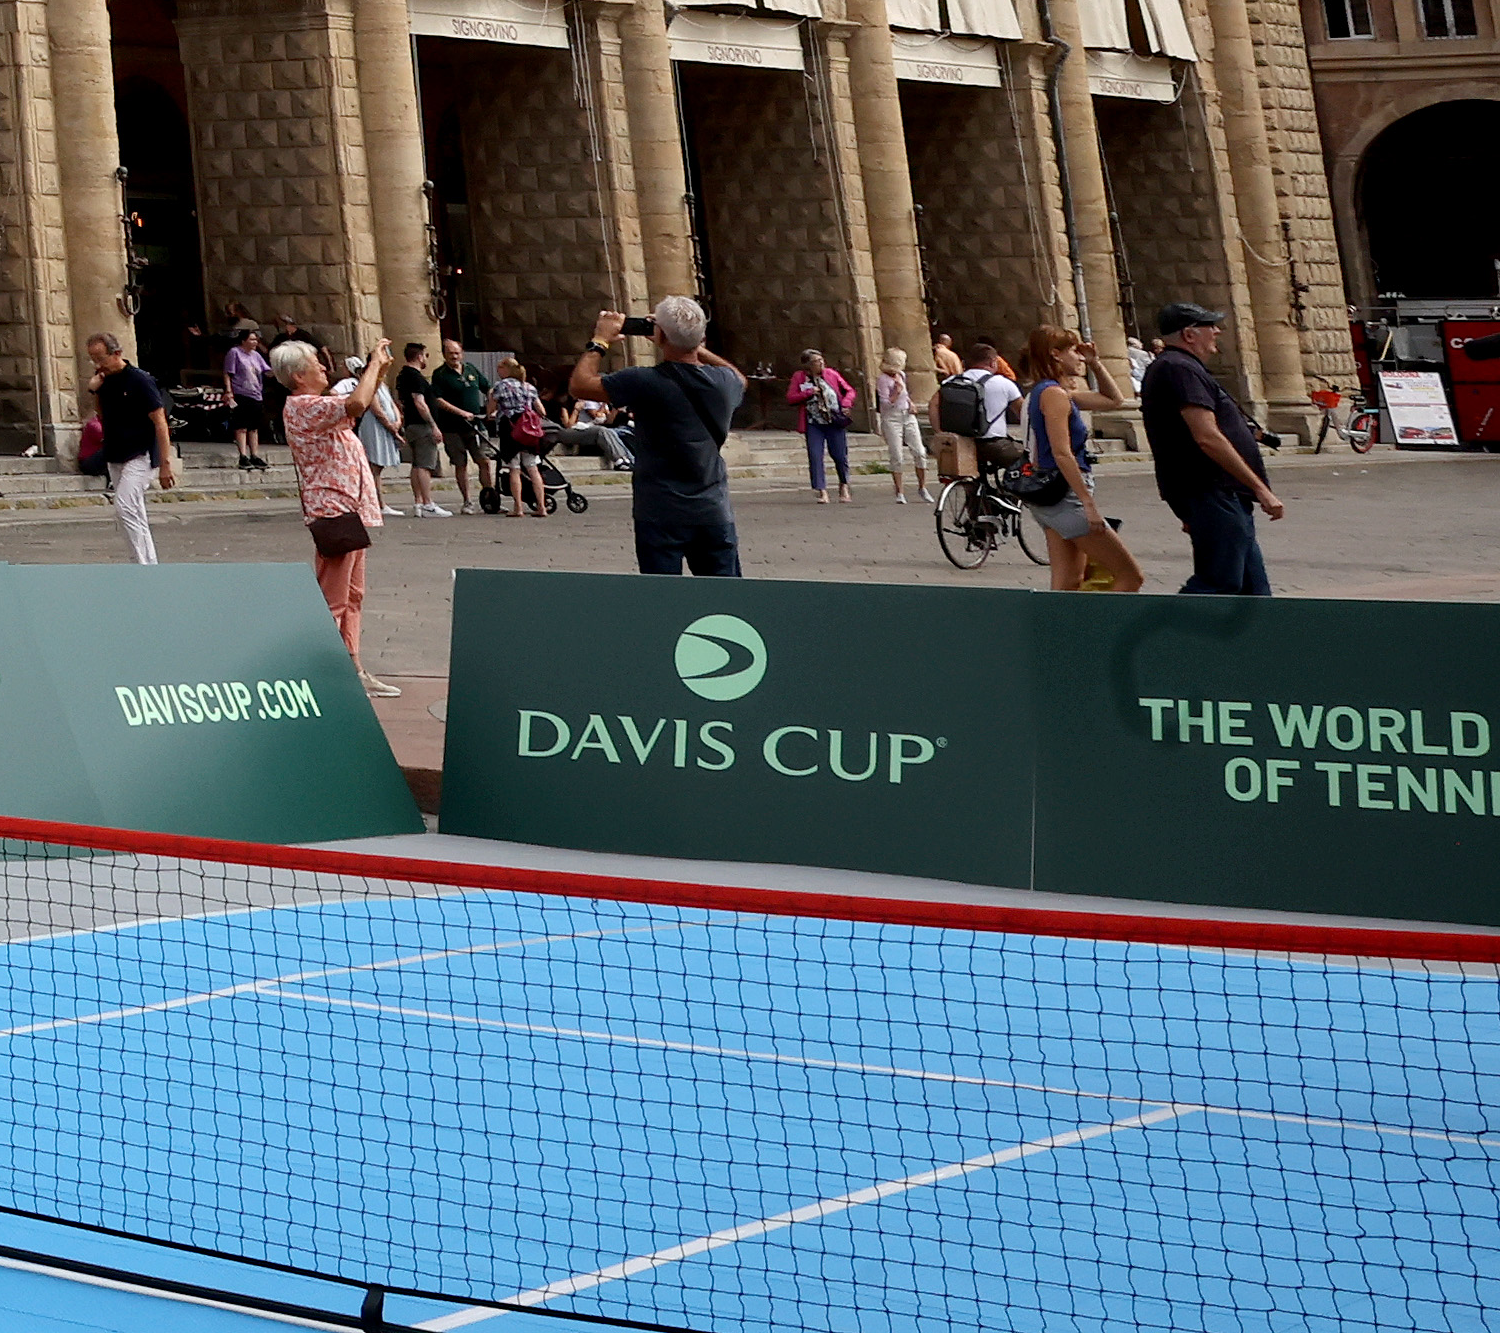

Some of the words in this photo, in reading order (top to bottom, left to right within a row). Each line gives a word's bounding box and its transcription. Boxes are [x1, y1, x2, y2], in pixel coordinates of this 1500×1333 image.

[452, 18, 517, 40] SIGNORVINO
[707, 45, 762, 64] SIGNORVINO
[916, 63, 963, 81] SIGNORVINO
[1099, 78, 1142, 96] SIGNORVINO
[114, 678, 322, 727] DAVISCUP.COM
[1138, 697, 1254, 746] THE
[1266, 702, 1491, 757] WORLD
[517, 709, 735, 771] DAVIS
[763, 725, 936, 785] CUP
[1224, 757, 1301, 803] OF
